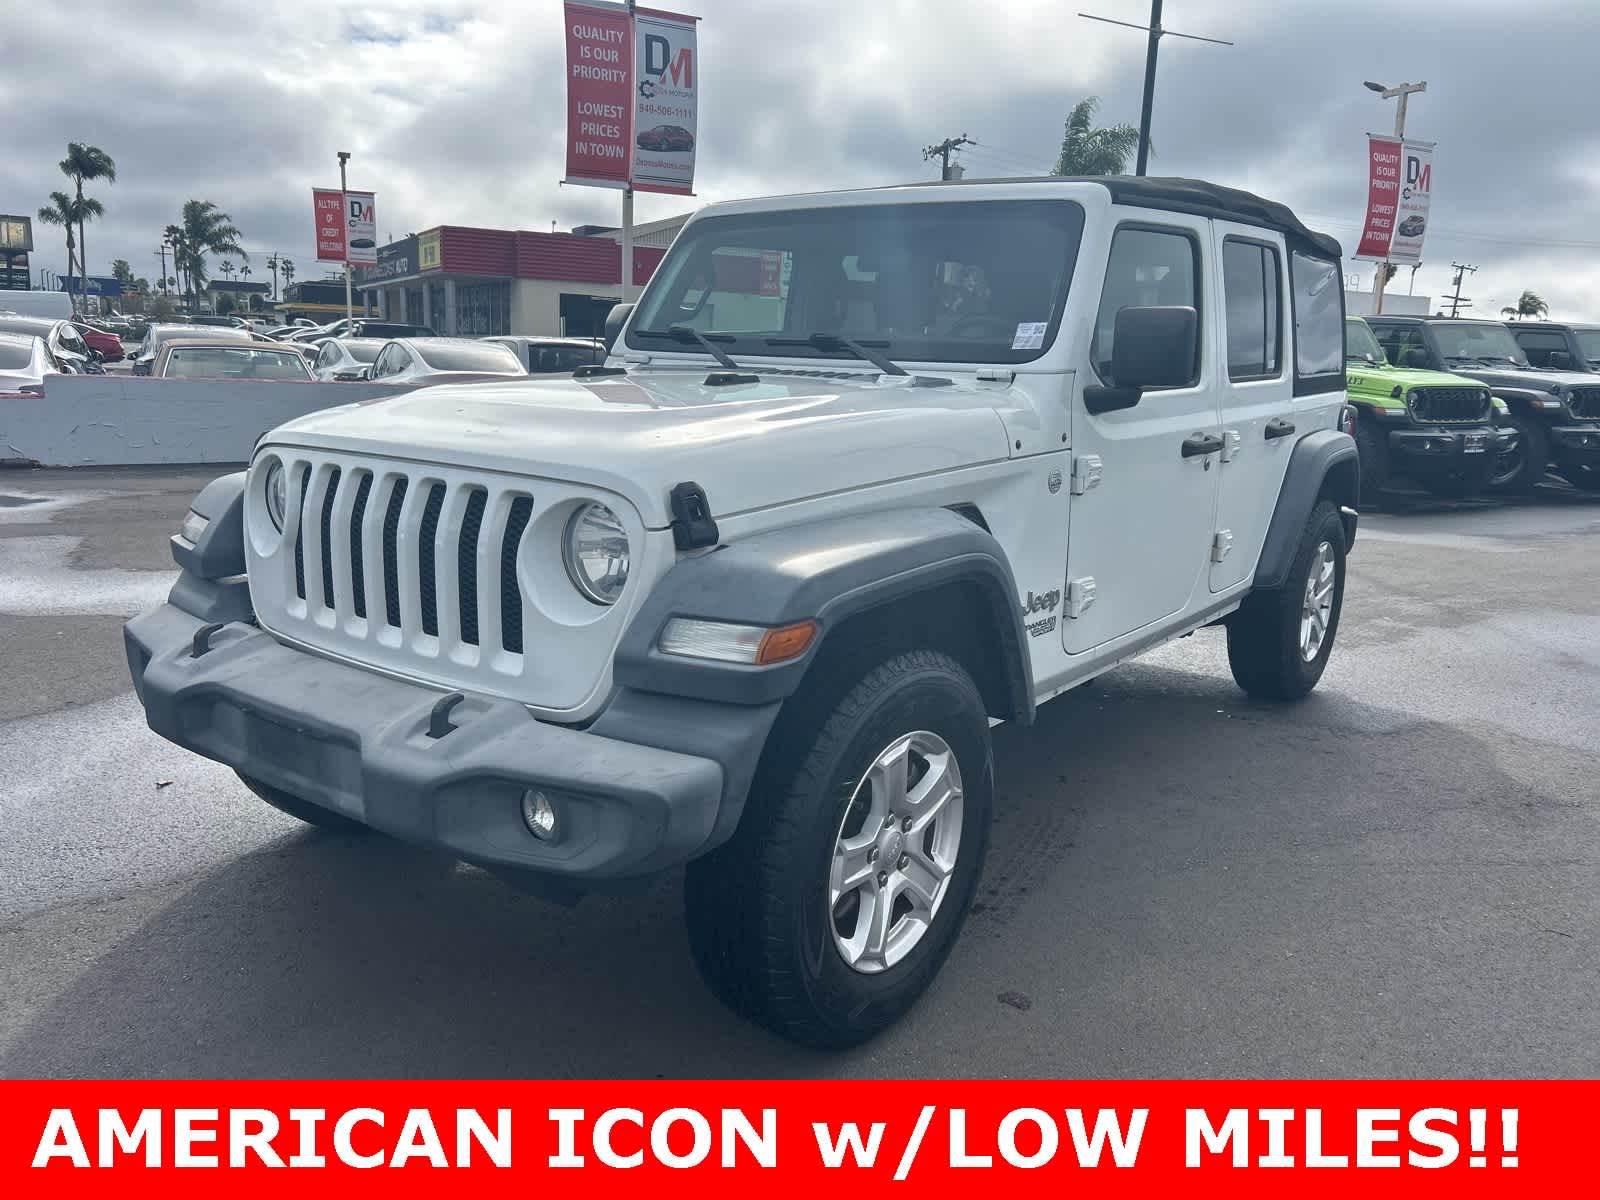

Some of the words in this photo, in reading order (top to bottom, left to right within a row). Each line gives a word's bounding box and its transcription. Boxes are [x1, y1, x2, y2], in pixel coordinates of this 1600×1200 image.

[572, 24, 624, 44] QUALITY
[580, 45, 592, 58] IS
[593, 47, 619, 62] OUR
[645, 34, 692, 89] DM
[573, 64, 627, 83] PRIORITY
[577, 101, 624, 119] LOWEST
[581, 122, 620, 138] PRICES
[575, 142, 588, 154] IN
[590, 143, 624, 158] TOWN
[1373, 152, 1399, 163] QUALITY
[1376, 167, 1382, 176] IS
[1382, 167, 1396, 177] OUR
[1372, 179, 1399, 191] PRIORITY
[318, 199, 328, 209] ALL
[327, 199, 340, 209] TYPE
[1371, 204, 1395, 215] LOWEST
[326, 213, 334, 223] OF
[1371, 217, 1391, 228] PRICES
[1366, 231, 1373, 240] IN
[1373, 232, 1390, 241] TOWN
[1023, 589, 1060, 616] Jeep
